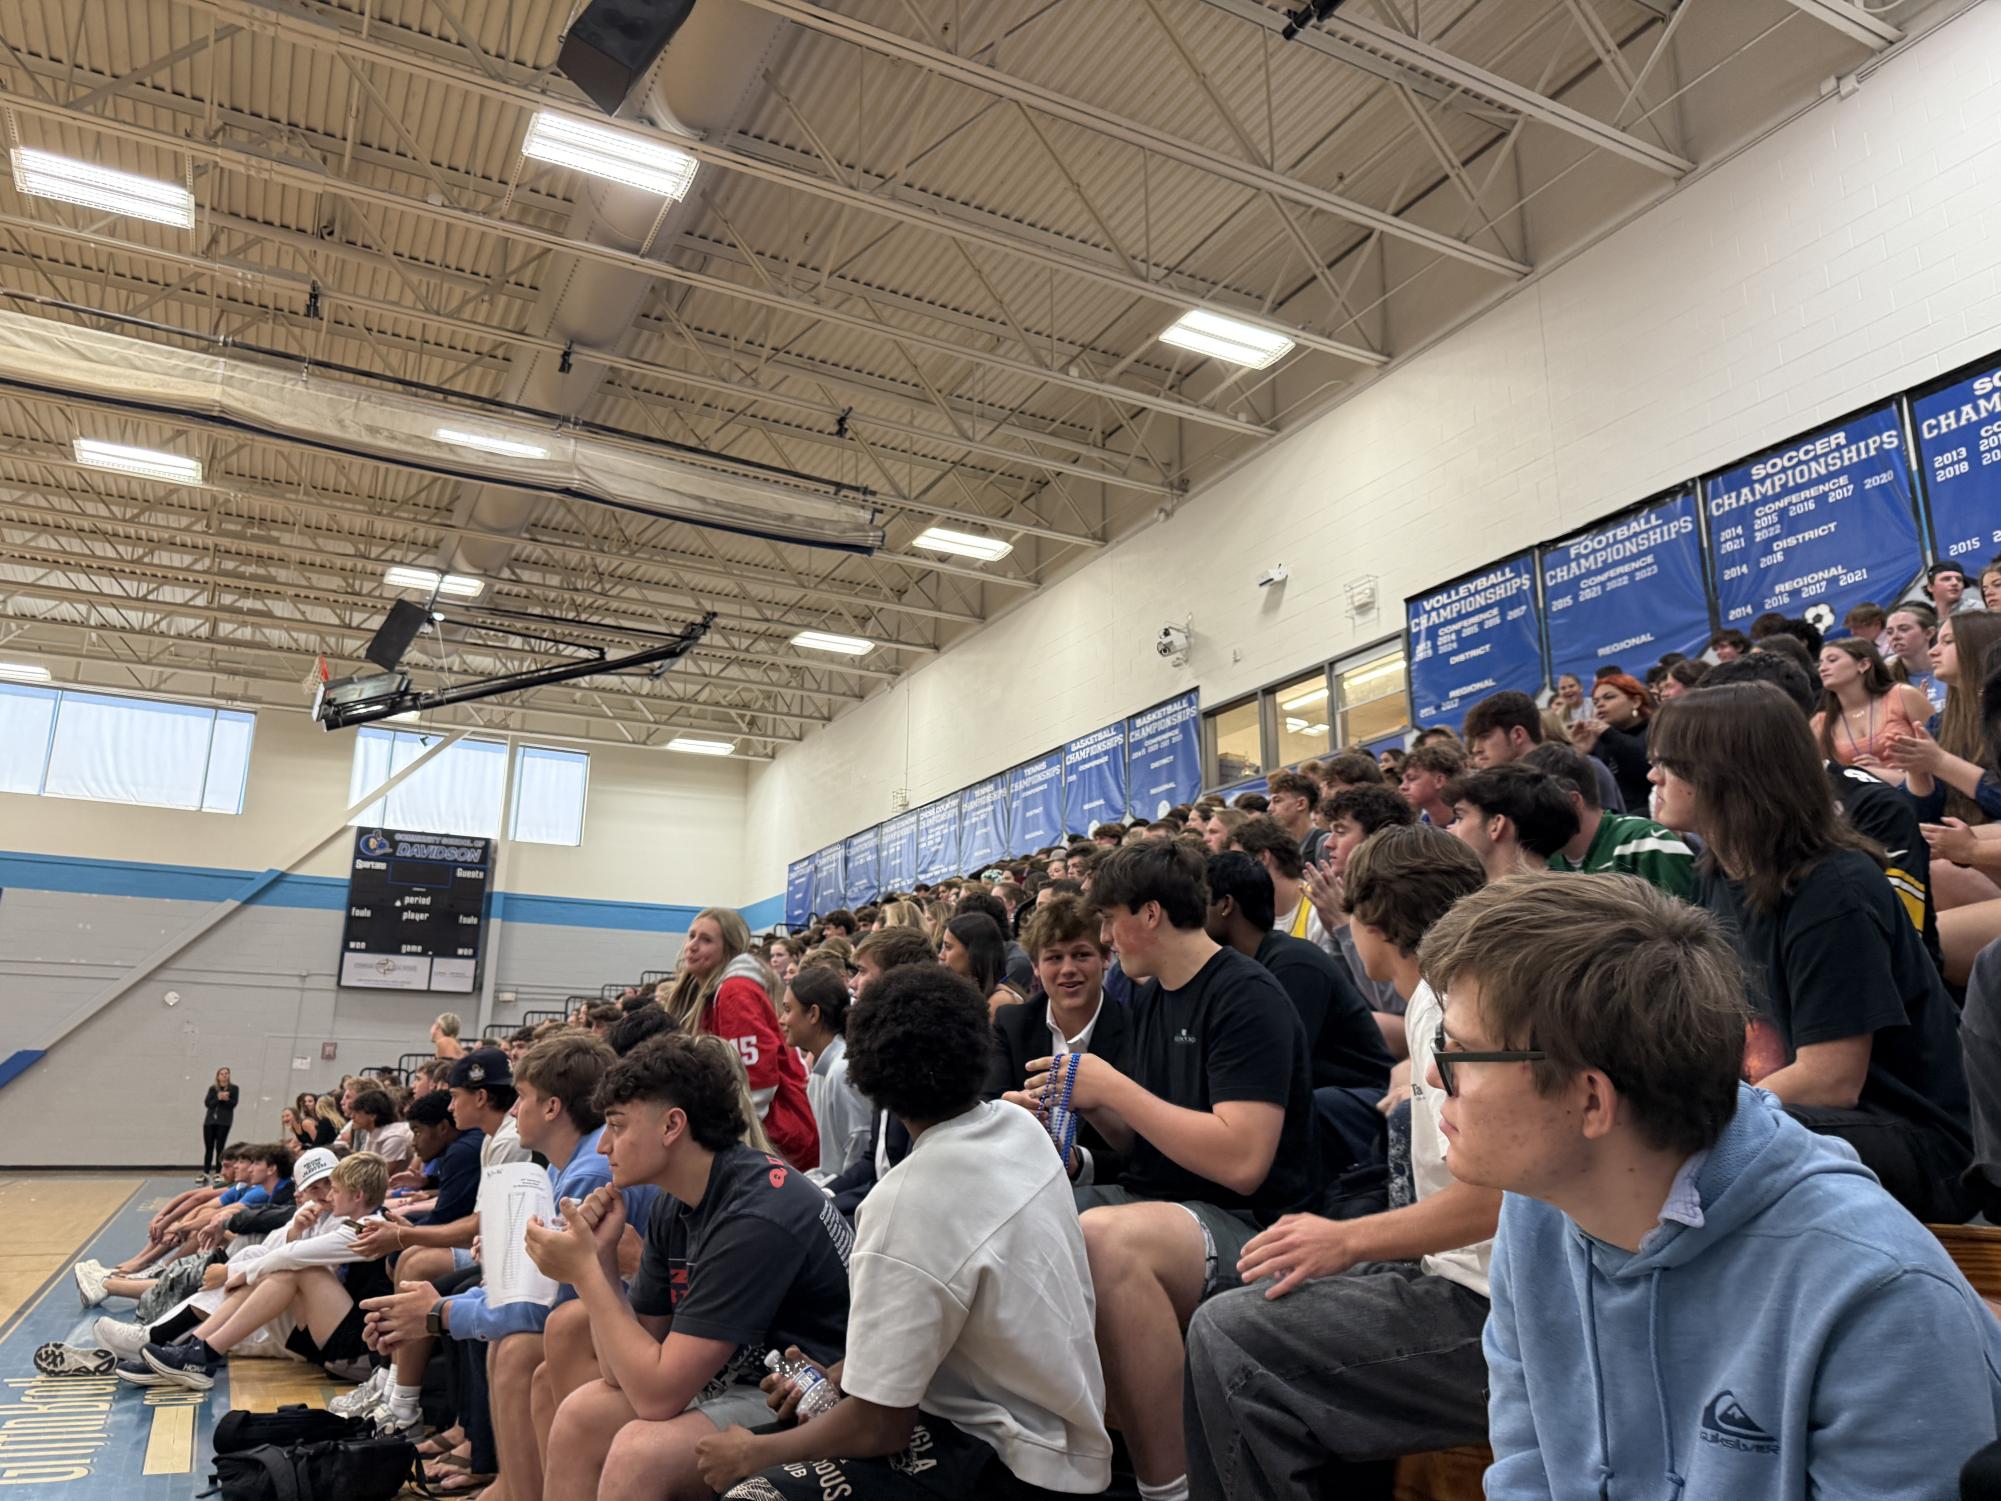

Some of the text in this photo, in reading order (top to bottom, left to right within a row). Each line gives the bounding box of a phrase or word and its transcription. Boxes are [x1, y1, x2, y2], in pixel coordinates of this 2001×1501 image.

[1751, 431, 1847, 480] SOCCER
[1934, 447, 1967, 469] 2013
[1711, 430, 1899, 517] CHAMPIONSHIPS
[1936, 461, 1969, 483] 2018
[1720, 470, 1894, 541] 2014 2015 2016 2017 2020
[1754, 475, 1849, 518] CONFERENCE
[1569, 513, 1663, 559] FOOTBALL
[1721, 525, 1782, 554] 2021 2022
[1772, 521, 1838, 552] DISTRICT
[1949, 537, 1981, 557] 2015
[1545, 516, 1693, 587] CHAMPIONSHIPS
[1723, 551, 1785, 581] 2014 2016
[1580, 554, 1655, 588] CONFERENCE
[1774, 564, 1848, 594] REGIONAL
[1411, 574, 1531, 633] CHAMPIONSHIPS
[1423, 567, 1515, 611] VOLLEYBALL
[1578, 585, 1602, 602] 2021
[1728, 568, 1868, 621] 2014 2016 2017 2021
[1438, 607, 1499, 636] CONFERENCE
[1450, 644, 1491, 665] DISTRICT
[1597, 632, 1655, 656] REGIONAL
[1449, 678, 1496, 699] REGIONAL
[1130, 705, 1197, 743] CHAMPIONSHIPS
[1135, 698, 1188, 728] BASKETBALL
[1066, 734, 1123, 765] CHAMPIONSHIPS
[1071, 727, 1117, 752] BASKETBALL
[396, 842, 482, 863] DAVIDSON
[404, 895, 431, 906] period
[351, 907, 478, 925] fouls player fouls
[401, 944, 423, 953] game
